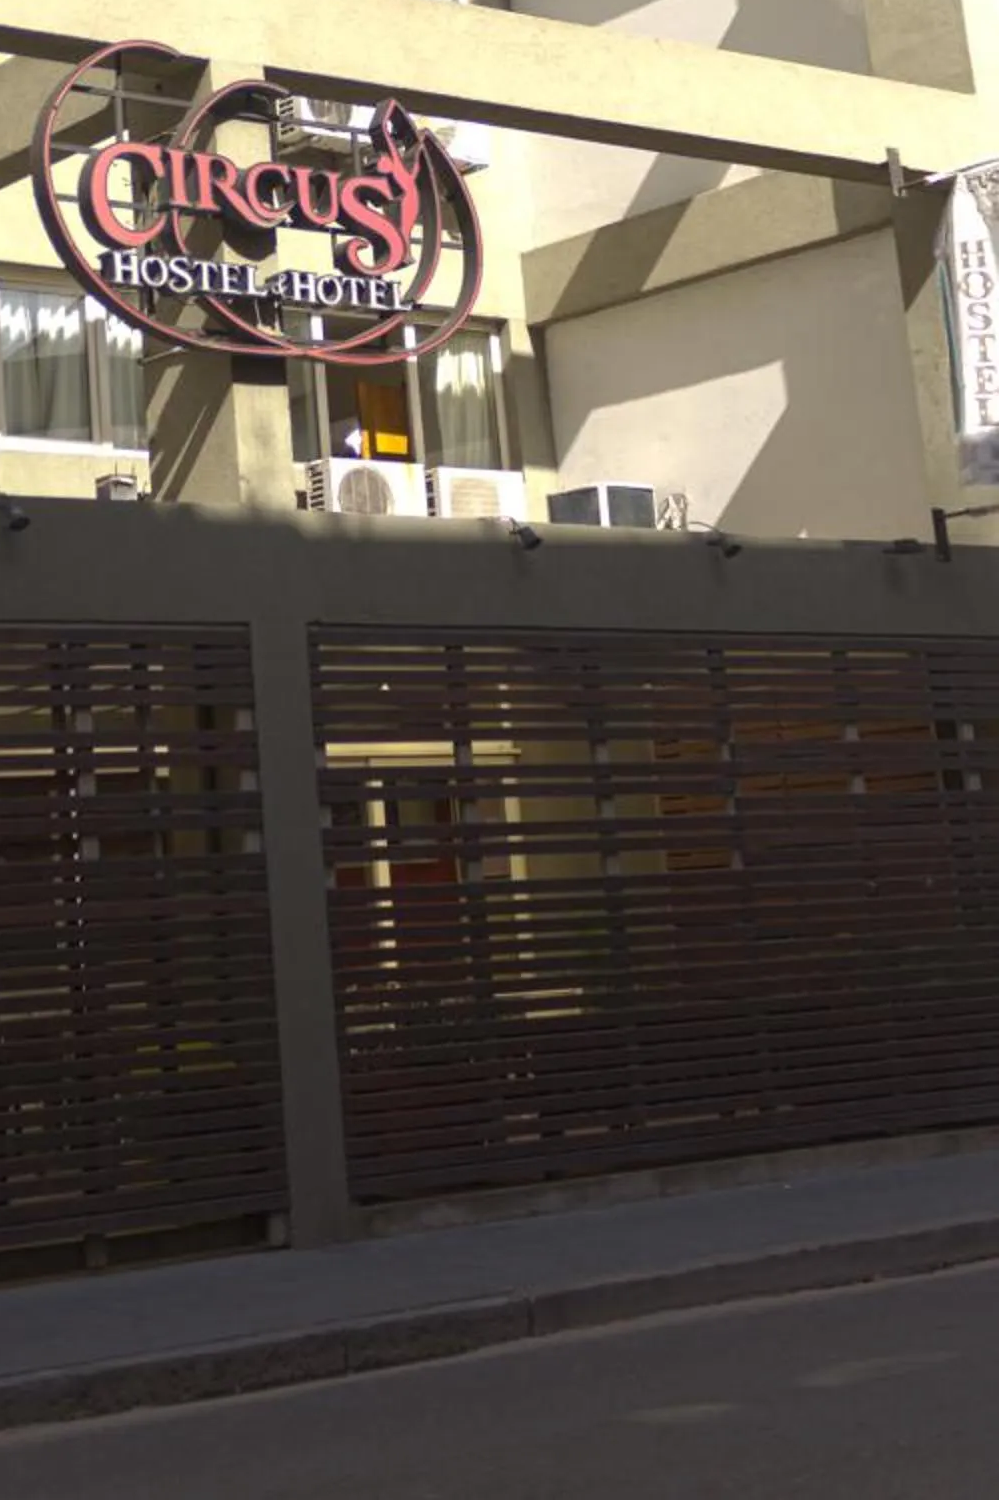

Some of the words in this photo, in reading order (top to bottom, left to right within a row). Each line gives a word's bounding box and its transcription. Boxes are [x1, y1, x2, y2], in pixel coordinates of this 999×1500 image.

[89, 140, 421, 276] CIRCUS
[111, 249, 270, 299] HOSTEL
[292, 269, 413, 313] HOTEL
[959, 240, 999, 427] HOSTEL
